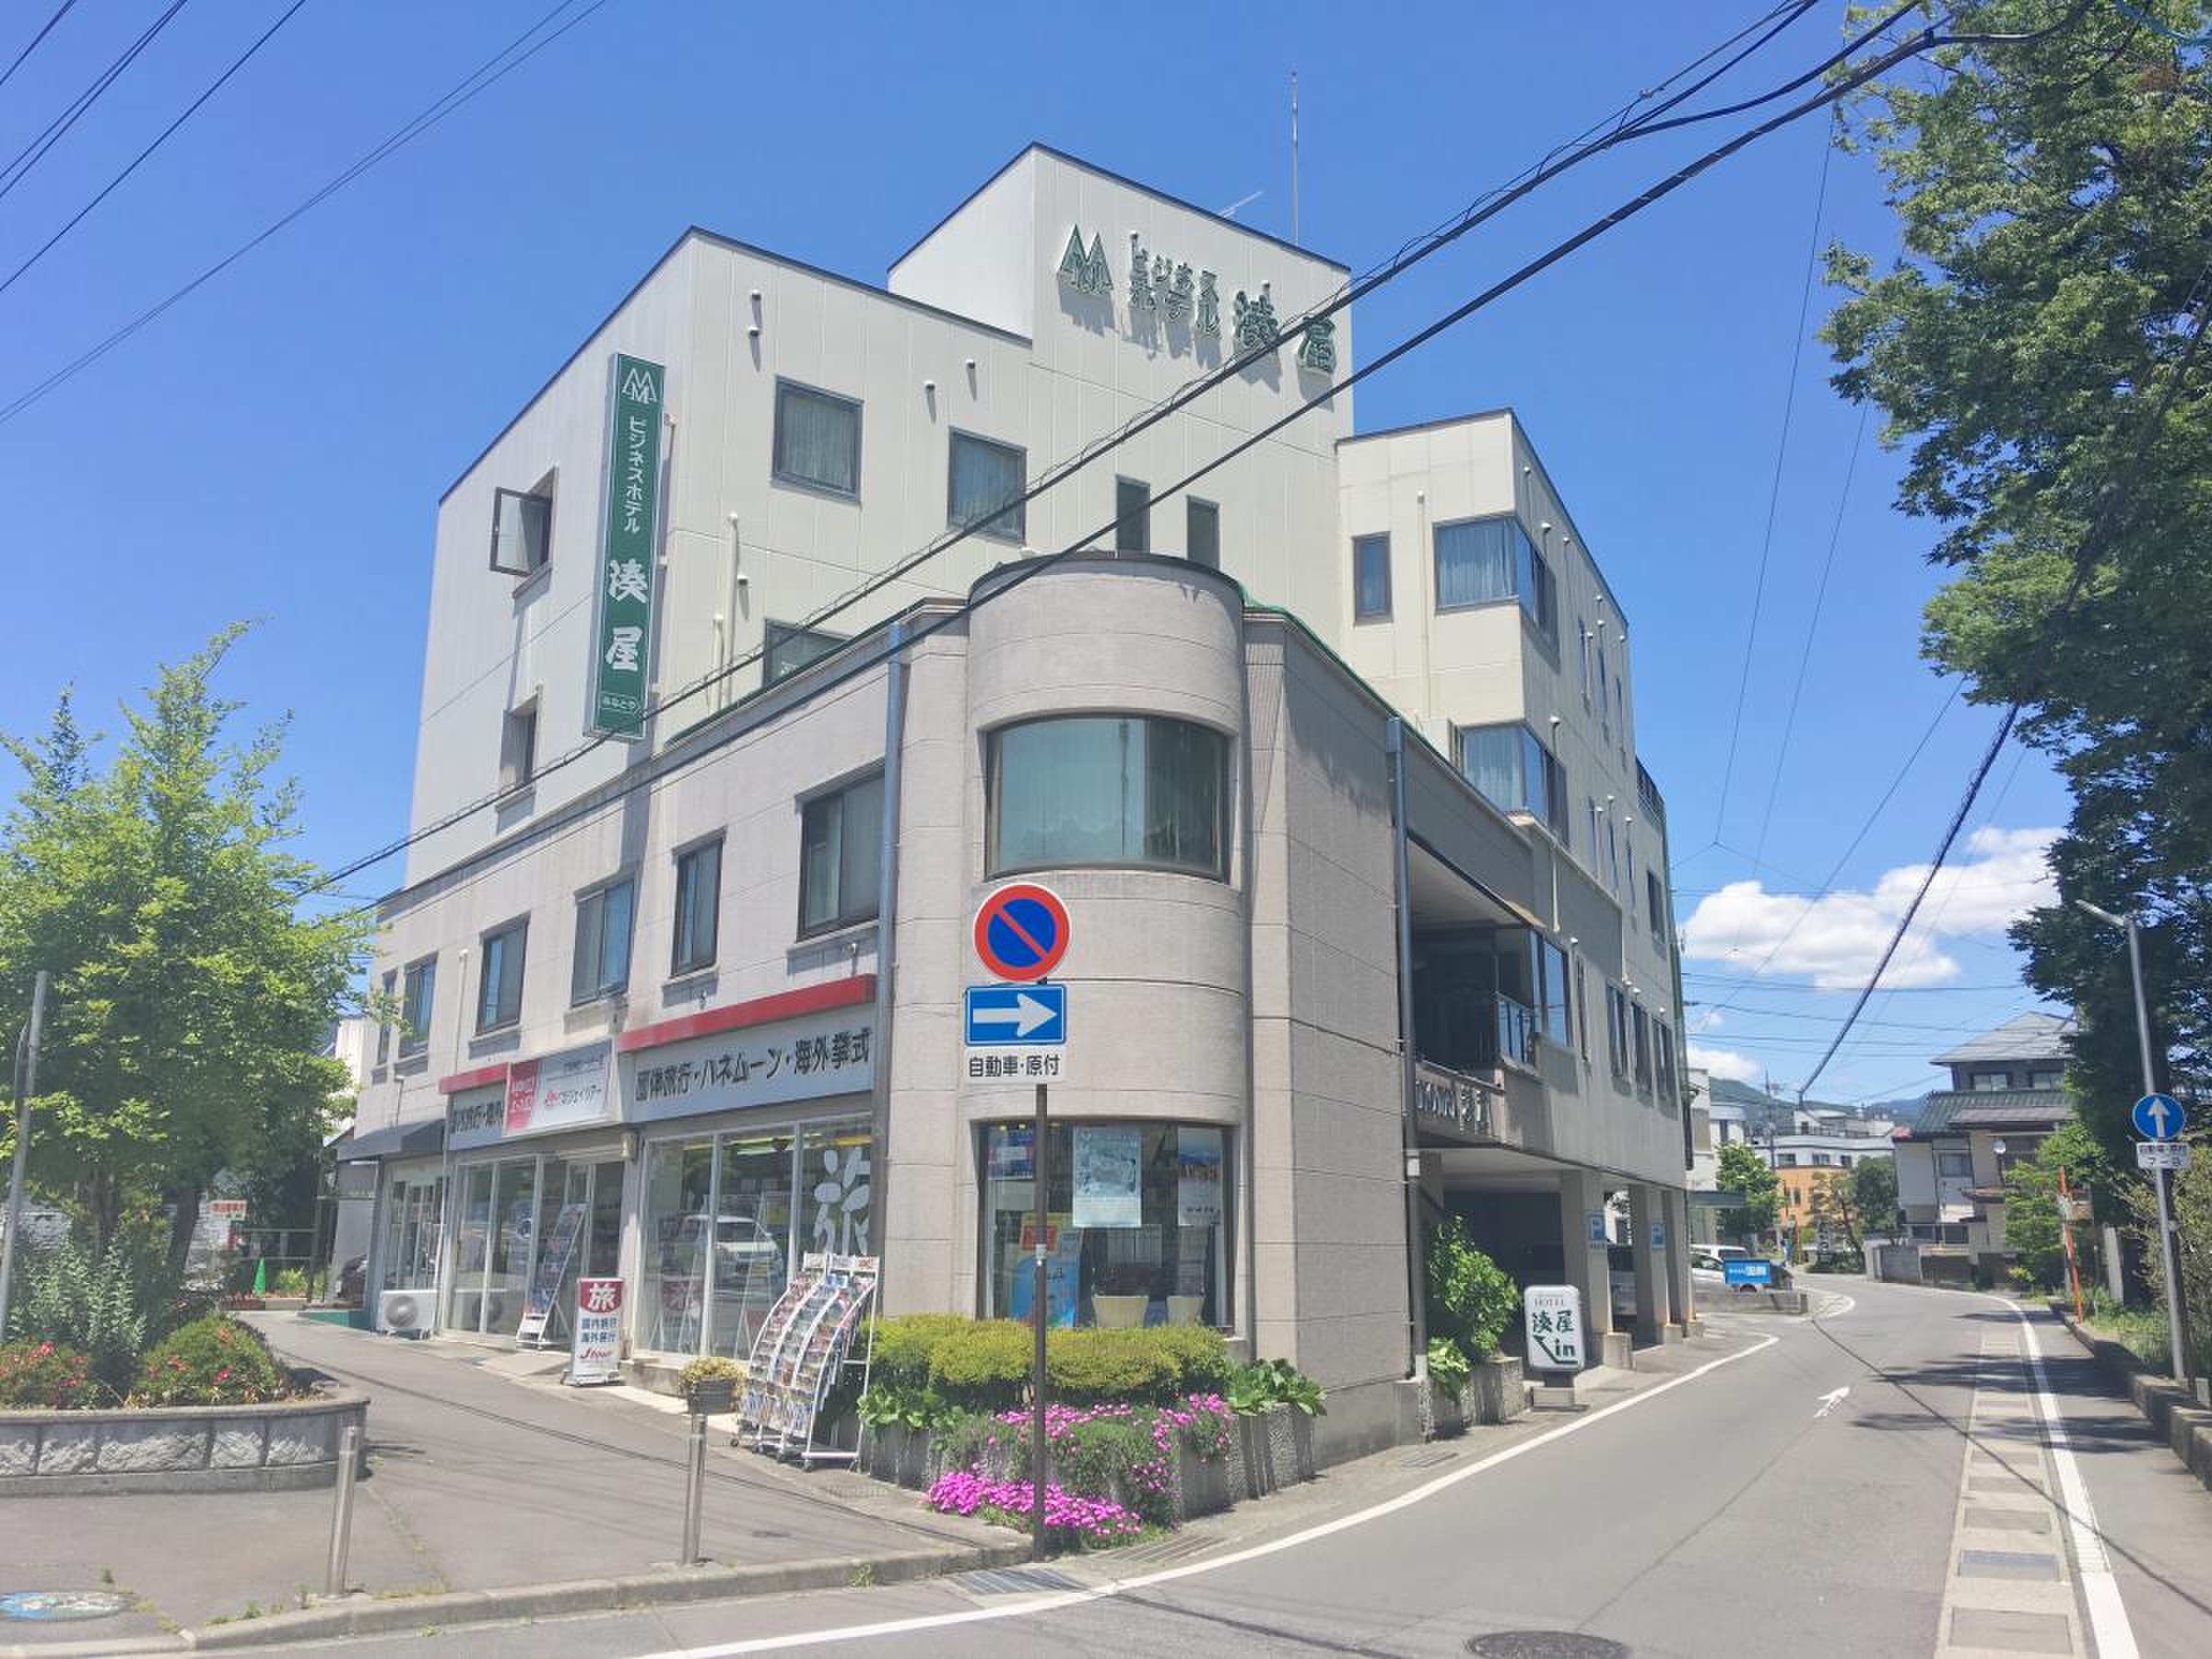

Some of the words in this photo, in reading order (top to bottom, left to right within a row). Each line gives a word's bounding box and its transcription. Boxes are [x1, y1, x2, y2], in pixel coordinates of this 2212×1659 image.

[623, 416, 647, 534] ビジネスホテル
[605, 559, 649, 672] 湊屋
[968, 1053, 1061, 1077] 自動車・原付
[587, 1282, 617, 1312] 旅
[1532, 1311, 1575, 1334] 湊屋
[1555, 1338, 1576, 1358] in
